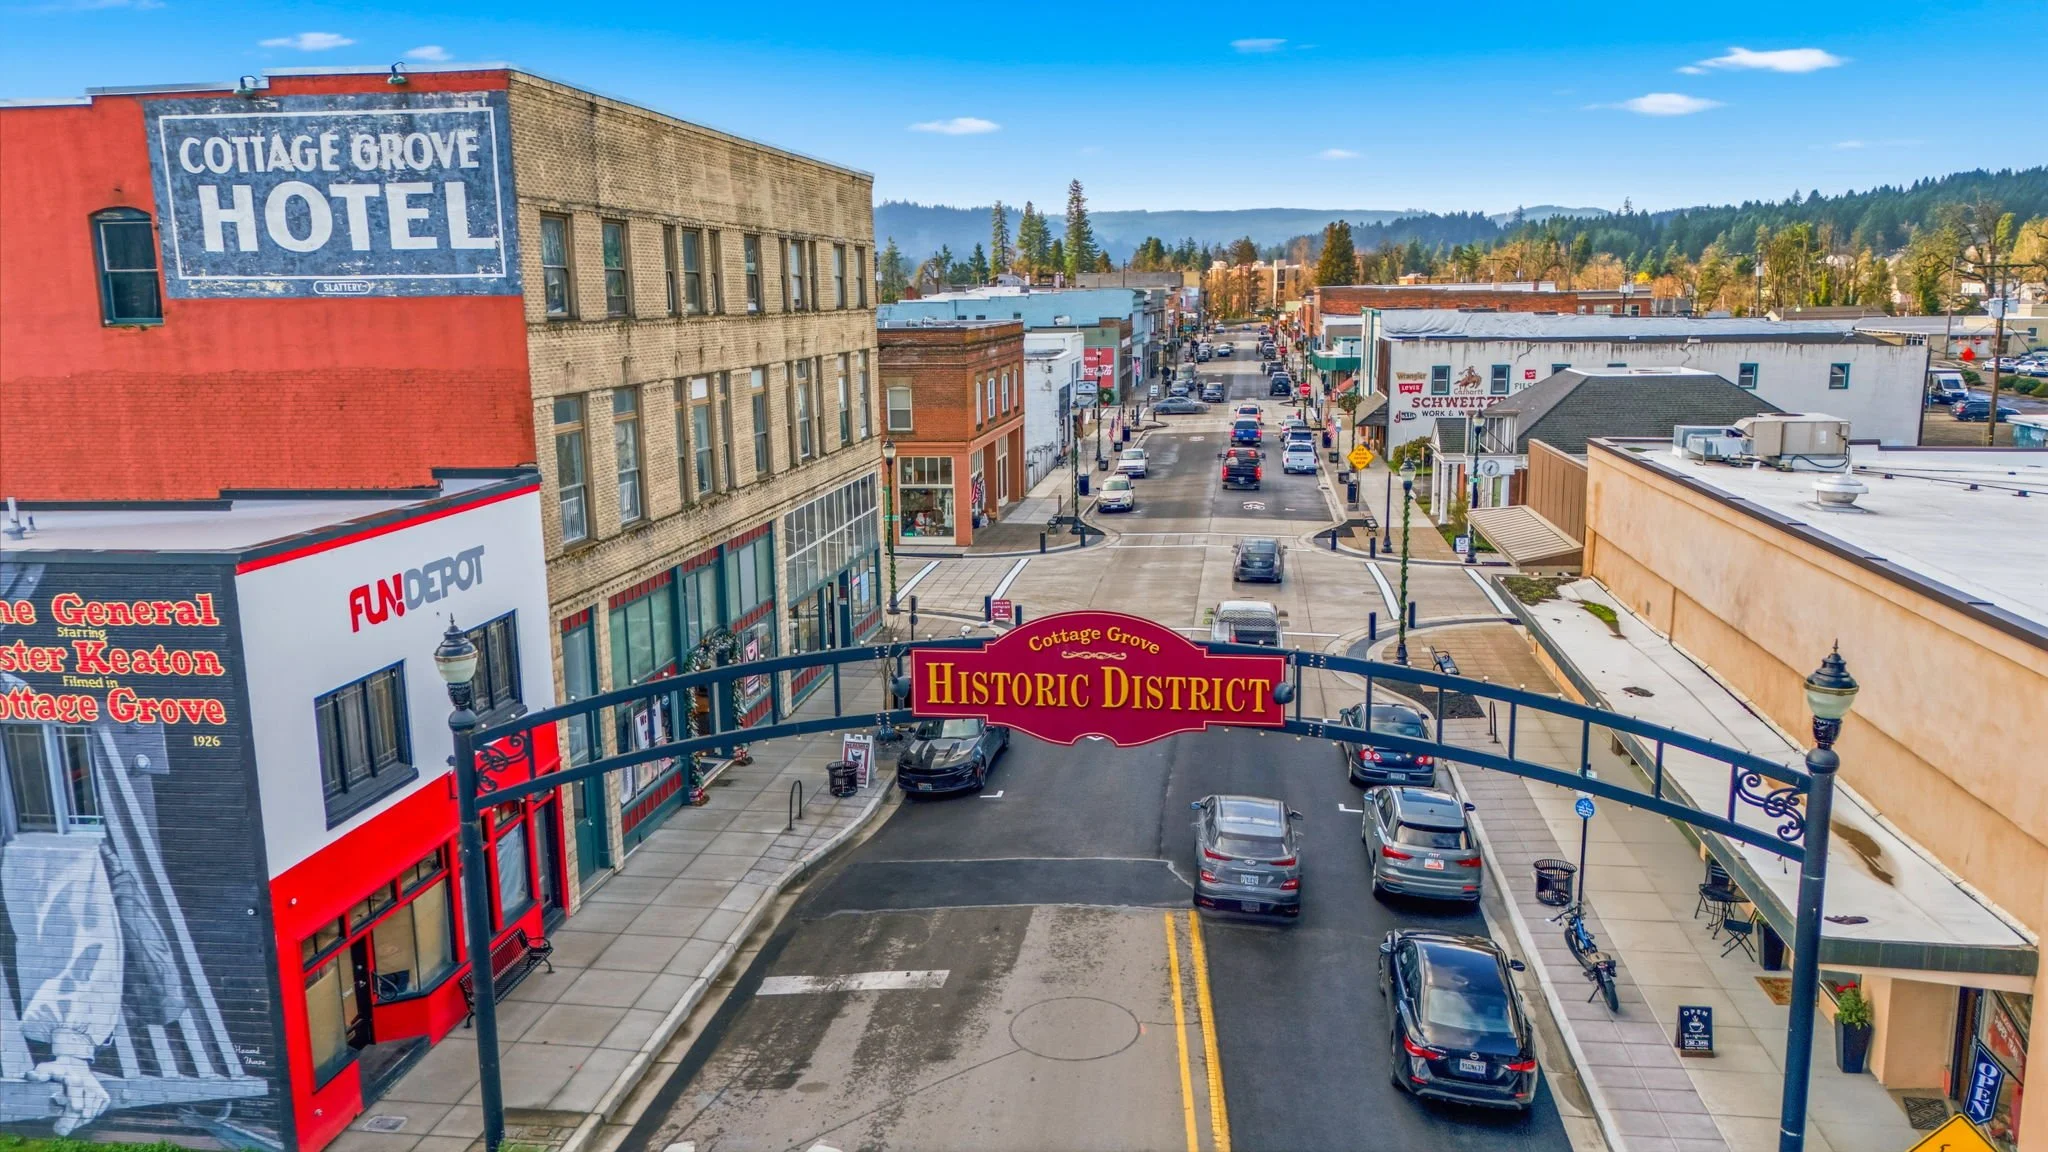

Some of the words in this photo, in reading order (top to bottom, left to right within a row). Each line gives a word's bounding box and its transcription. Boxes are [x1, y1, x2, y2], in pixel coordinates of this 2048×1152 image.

[178, 133, 340, 175] COTTAGE
[351, 129, 480, 172] GROVE
[197, 180, 497, 253] HOTEL
[323, 283, 361, 292] SLATTERY
[1396, 371, 1427, 381] Wrangler
[1448, 409, 1454, 417] &
[52, 592, 220, 627] General
[57, 626, 109, 641] Starring
[1028, 628, 1101, 651] Cottage
[1106, 626, 1160, 654] Grove
[72, 640, 225, 676] Keaton
[63, 675, 104, 688] Filmed
[105, 675, 119, 688] in
[925, 662, 1090, 708] HISTORIC
[1101, 665, 1271, 714] DISTRICT
[107, 687, 227, 725] Grove
[193, 736, 221, 747] 1926
[1683, 1008, 1708, 1017] OPEN
[1972, 1062, 1998, 1118] OPEN
